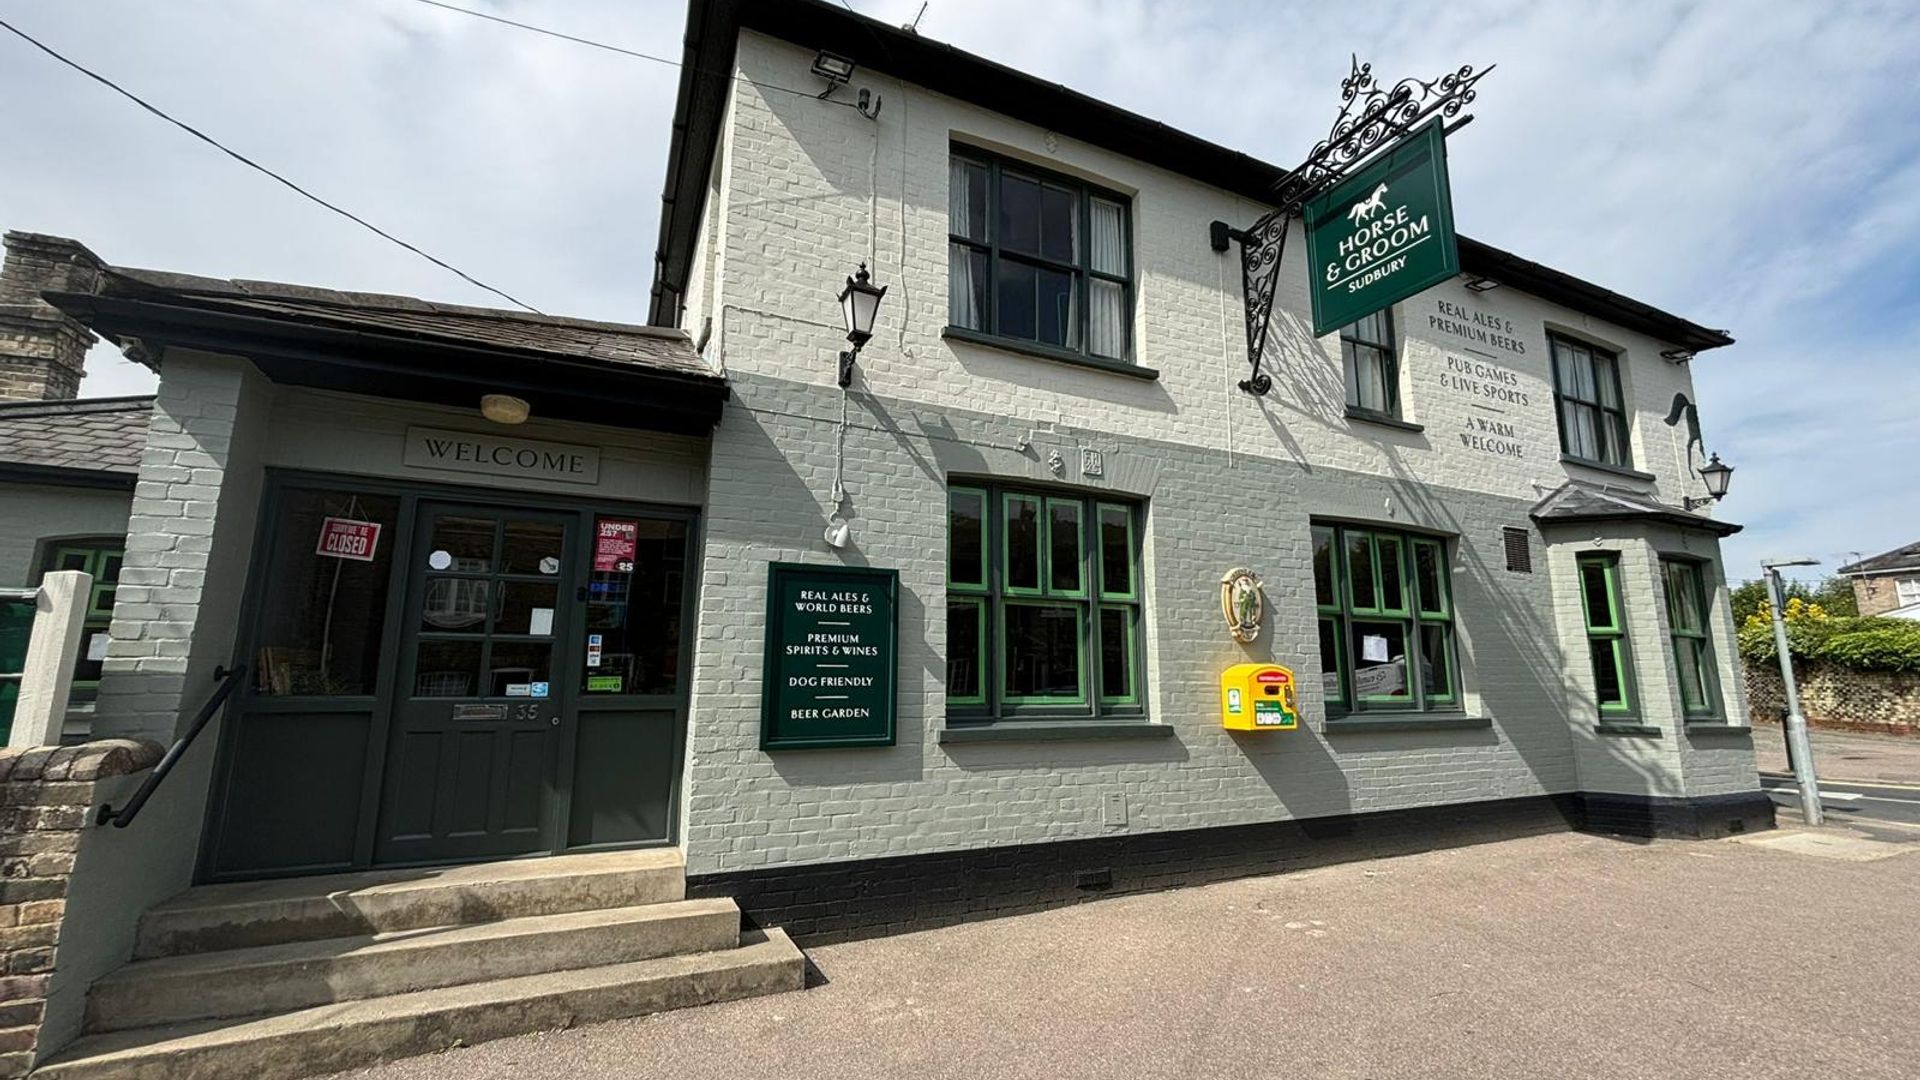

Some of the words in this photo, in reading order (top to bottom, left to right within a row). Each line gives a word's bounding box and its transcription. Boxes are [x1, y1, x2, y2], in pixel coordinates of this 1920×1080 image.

[1339, 205, 1409, 256] HORSE
[1326, 262, 1341, 282] &
[1345, 215, 1429, 270] GROOM
[1348, 255, 1407, 293] SUDBURY
[1438, 300, 1469, 321] REAL
[1472, 311, 1501, 330] ALES
[1504, 320, 1512, 334] &
[1429, 315, 1486, 344] PREMIUM
[1490, 333, 1526, 354] BEERS
[1447, 356, 1472, 374] PUB
[1475, 364, 1517, 386] GAMES
[1440, 373, 1448, 387] &
[1452, 376, 1480, 395] LIVE
[1483, 384, 1529, 407] SPORTS
[1466, 416, 1474, 430] A
[1477, 418, 1514, 438] WARM
[424, 437, 584, 474] WELCOME
[1460, 433, 1523, 459] WELCOME
[600, 522, 635, 532] UNDER
[326, 532, 368, 555] CLOSED
[619, 562, 634, 572] 25
[801, 590, 828, 601] REAL
[831, 592, 858, 603] ALES
[861, 593, 870, 603] &
[795, 602, 837, 613] WORLD
[840, 603, 873, 615] BEERS
[807, 633, 859, 644] PREMIUM
[786, 645, 829, 656] SPIRITS
[831, 645, 840, 656] &
[842, 646, 878, 657] WINES
[789, 676, 818, 687] DOG
[820, 676, 874, 687] FRIENDLY
[515, 704, 540, 720] 35
[790, 709, 819, 719] BEER
[821, 708, 870, 719] GARDEN
